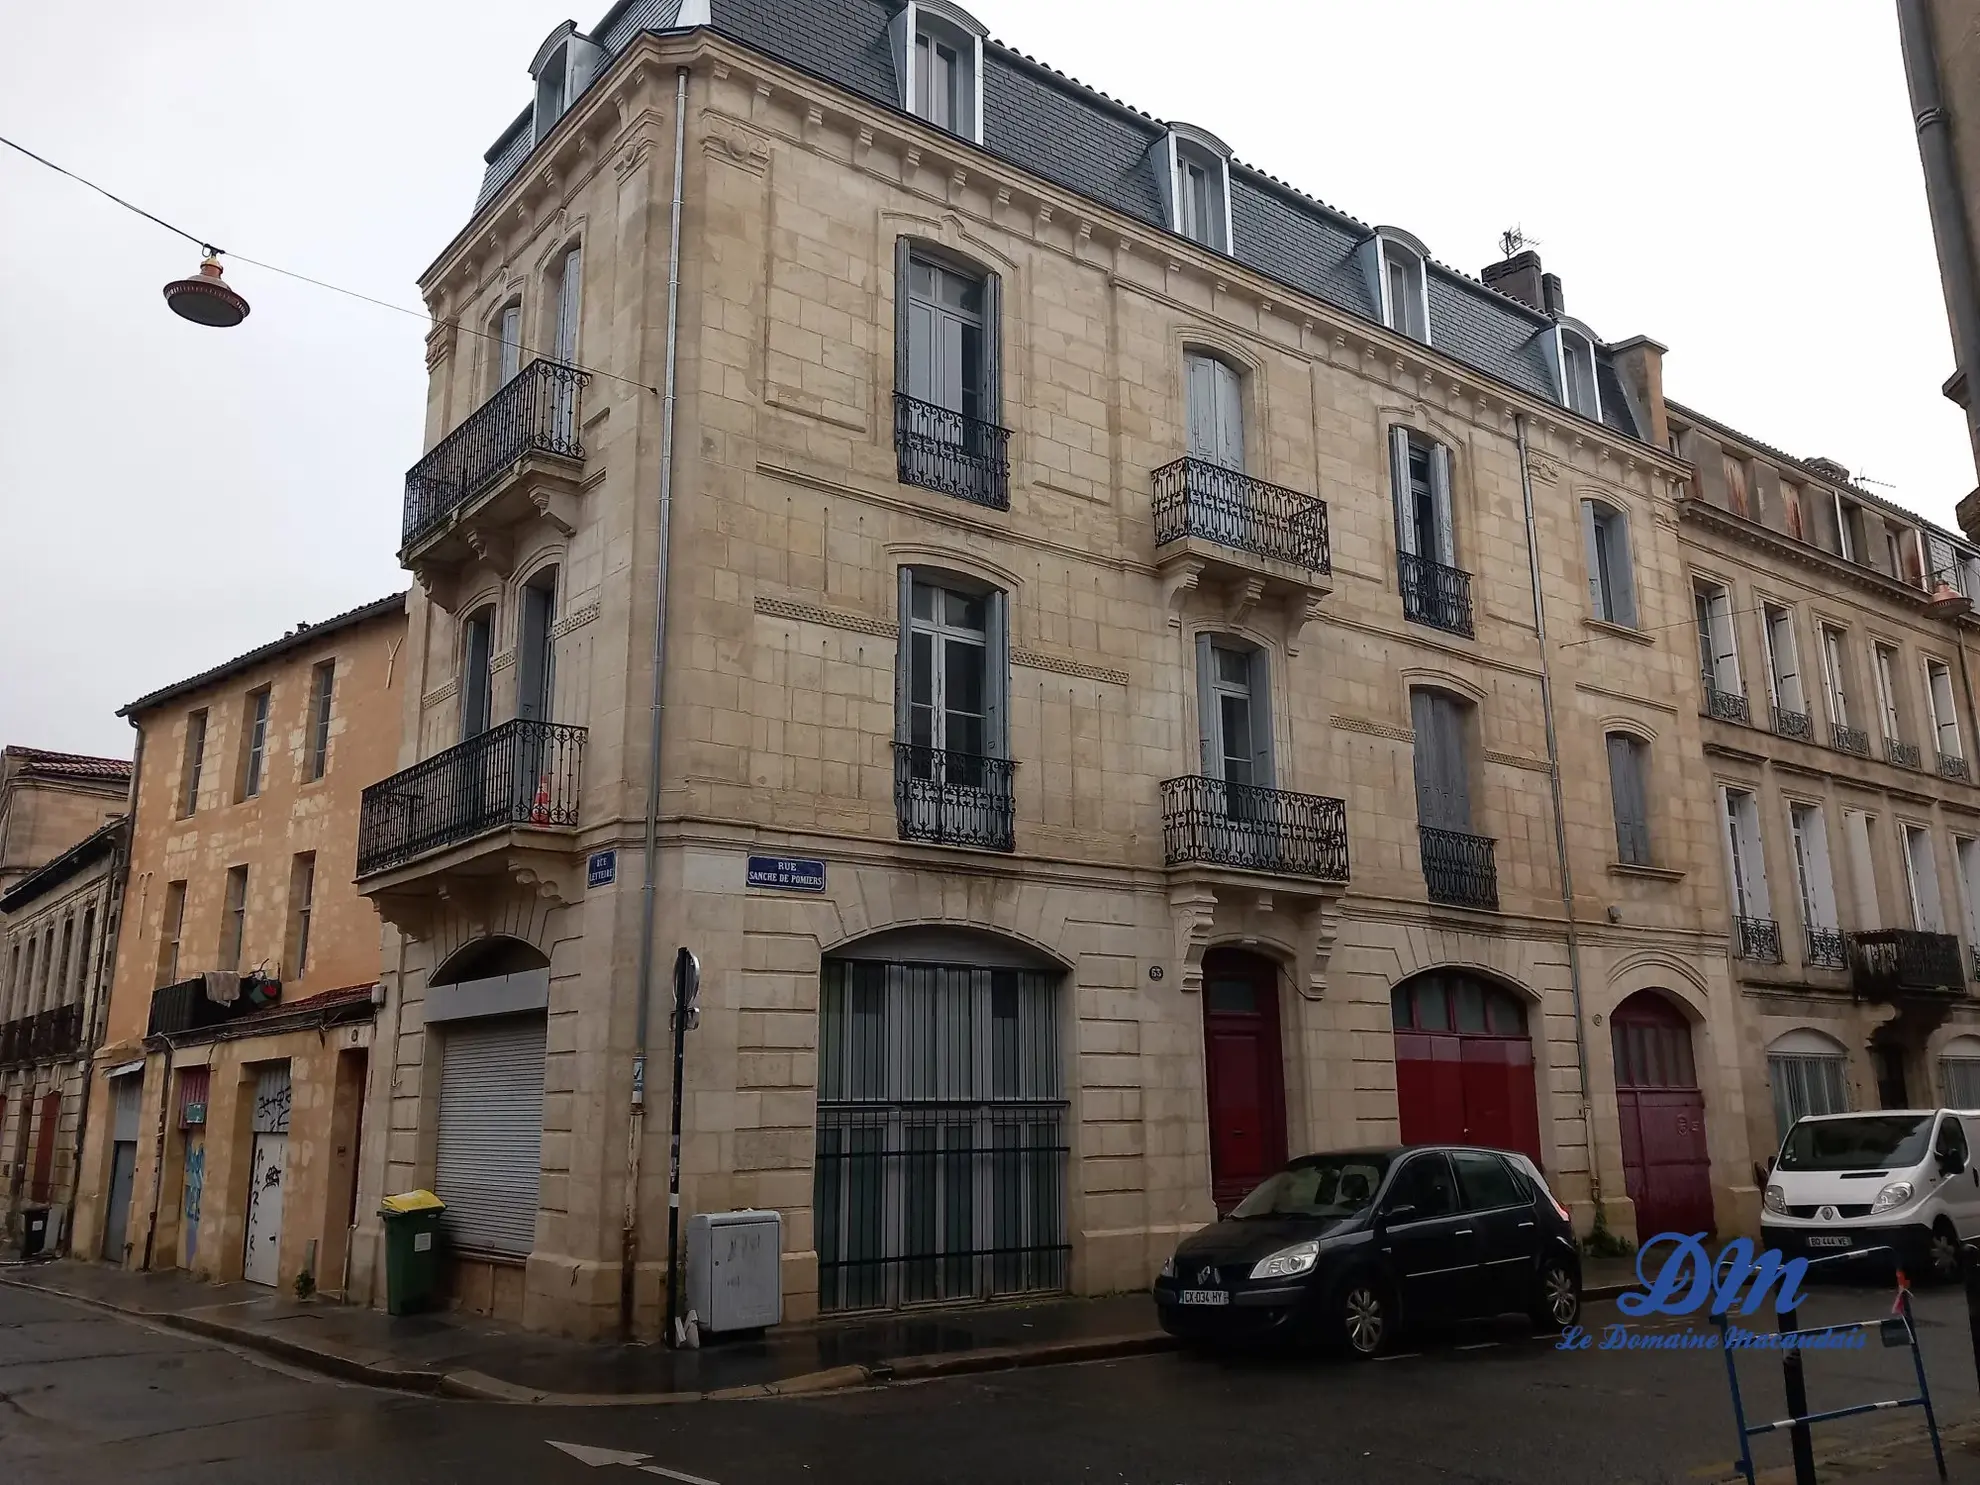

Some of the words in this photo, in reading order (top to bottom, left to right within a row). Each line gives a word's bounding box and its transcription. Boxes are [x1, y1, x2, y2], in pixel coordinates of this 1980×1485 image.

[778, 861, 797, 871] RUE
[748, 871, 778, 882] SANCHE
[779, 874, 790, 883] DE
[790, 874, 822, 886] POMIERS
